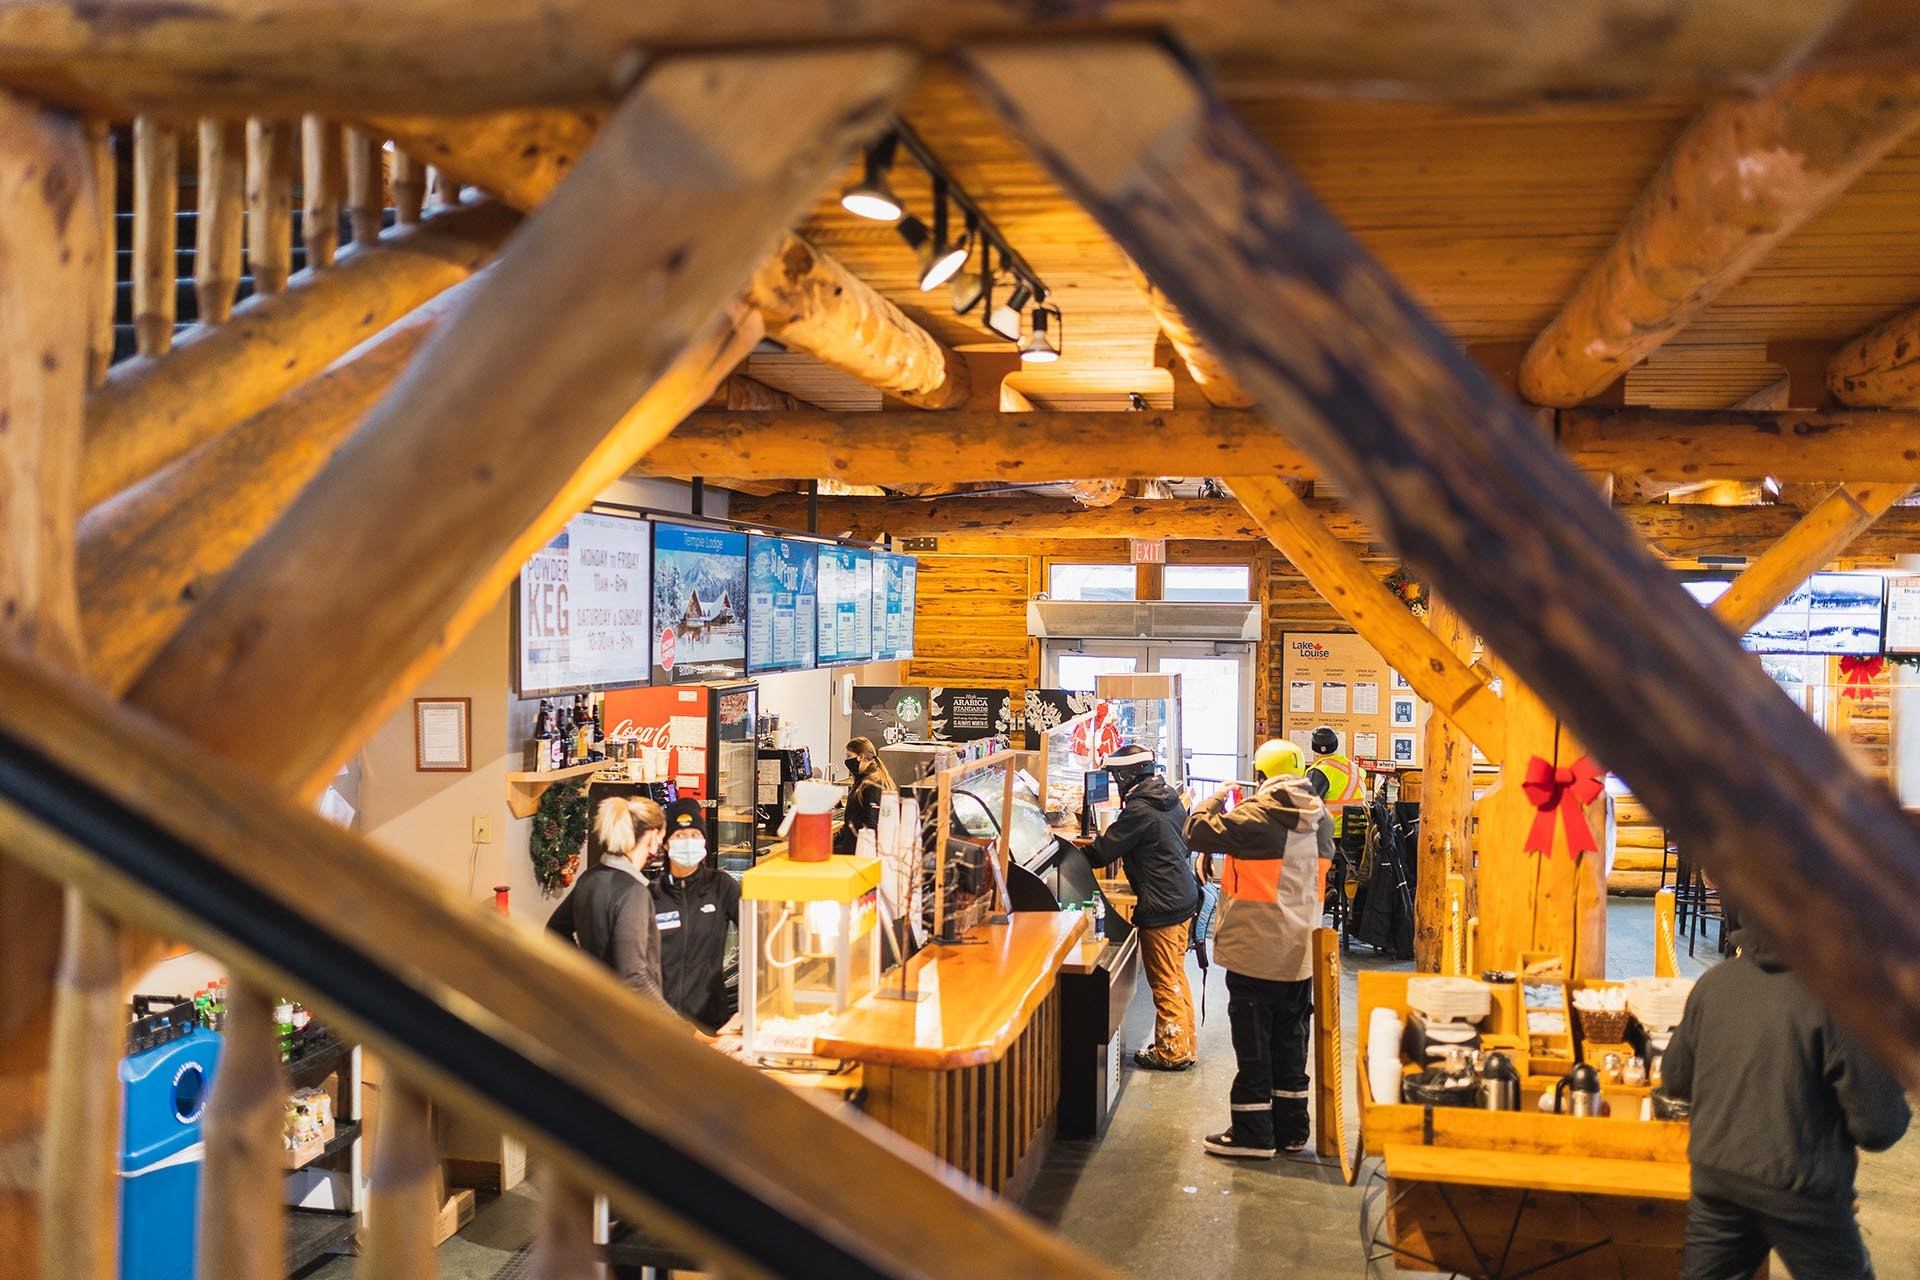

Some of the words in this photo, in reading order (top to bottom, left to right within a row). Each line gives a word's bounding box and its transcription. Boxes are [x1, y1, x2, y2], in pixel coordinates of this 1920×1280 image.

[684, 533, 705, 550] Temple
[705, 536, 724, 552] Lodge
[1136, 543, 1160, 561] EXIT
[580, 548, 608, 567] MONDAY
[616, 551, 640, 570] FRIDAY
[527, 557, 568, 582] POWDER
[527, 582, 568, 636] KEG
[575, 607, 610, 627] SATURDAY
[618, 607, 642, 627] SUNDAY
[1292, 641, 1313, 650] Lake
[1300, 649, 1329, 658] Louise
